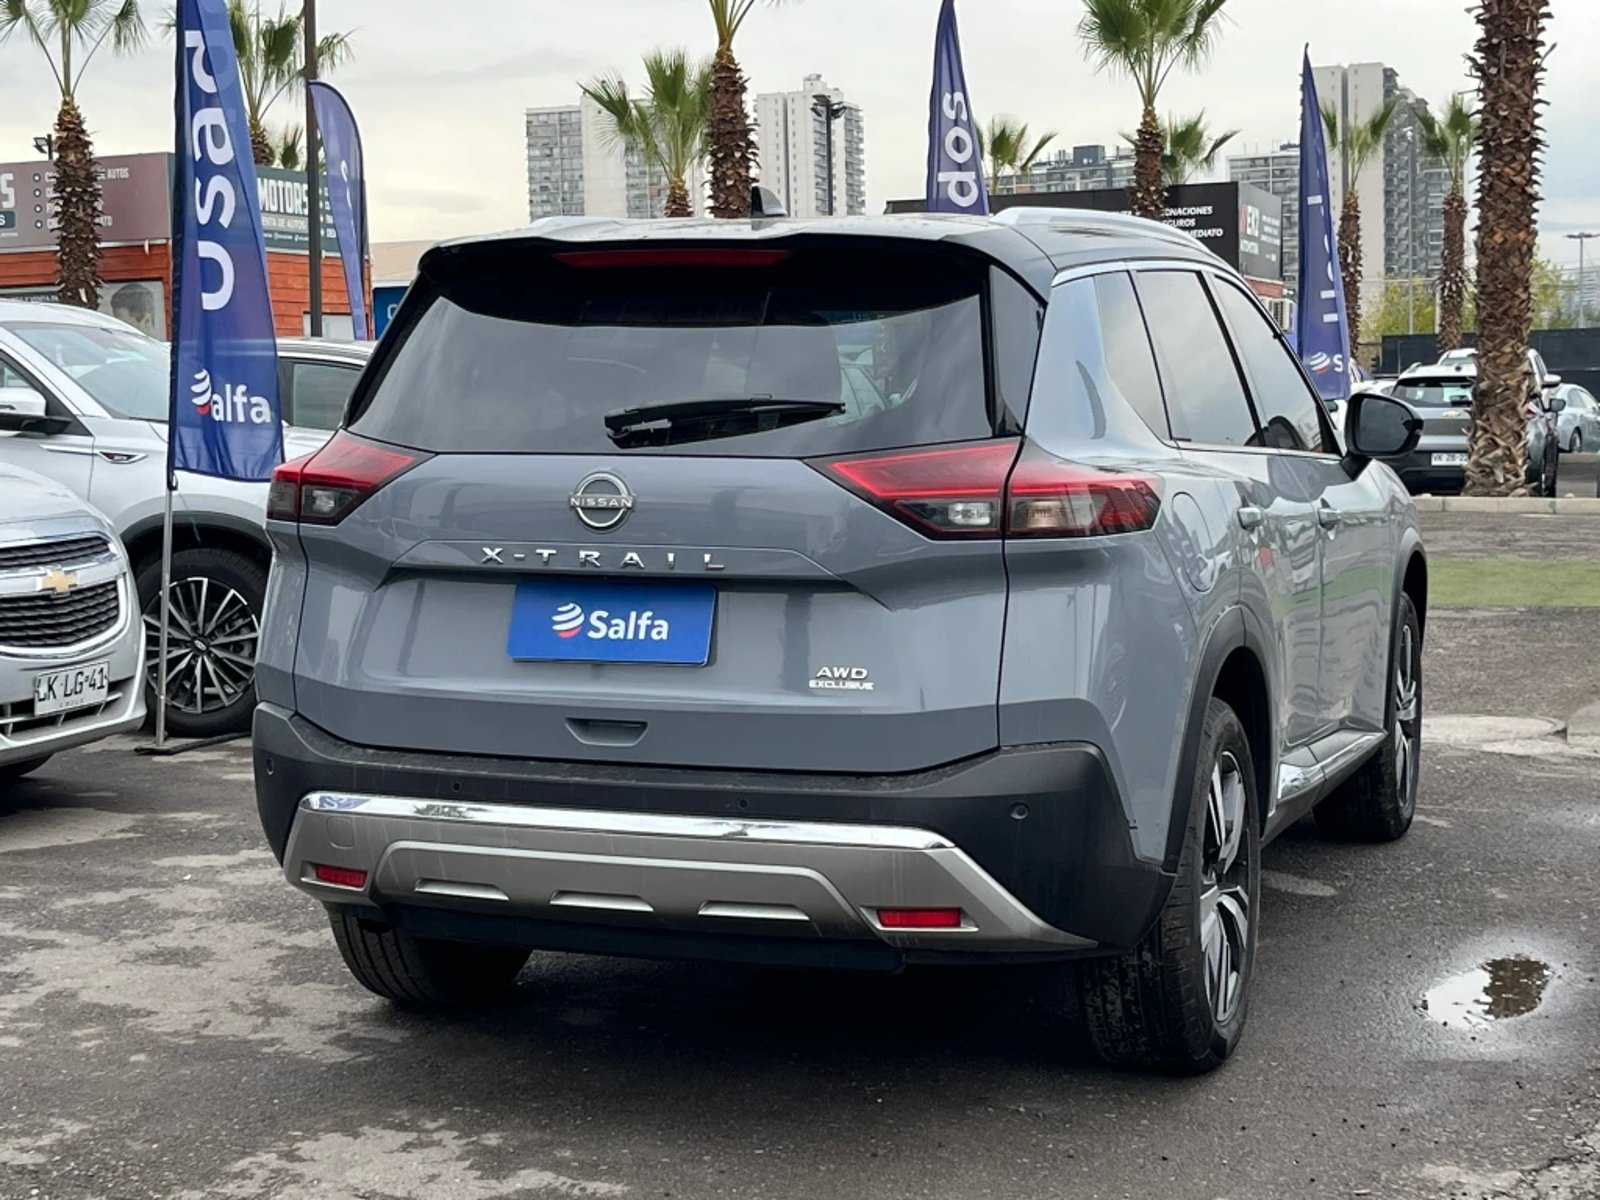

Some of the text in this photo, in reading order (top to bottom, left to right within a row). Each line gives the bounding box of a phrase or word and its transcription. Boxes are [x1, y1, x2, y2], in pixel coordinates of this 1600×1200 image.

[937, 91, 979, 207] dos
[107, 167, 129, 179] AUTOS
[257, 177, 309, 216] MOTORS
[1163, 206, 1213, 217] GNACIONES
[262, 216, 277, 226] ENTA
[1163, 219, 1196, 229] EGUROS
[211, 384, 271, 424] alfa
[570, 496, 633, 508] NISSAN
[481, 547, 725, 571] X-TRAIL
[587, 610, 669, 640] Salfa
[816, 666, 868, 679] AWD
[809, 679, 874, 691] EXCLUSIVE
